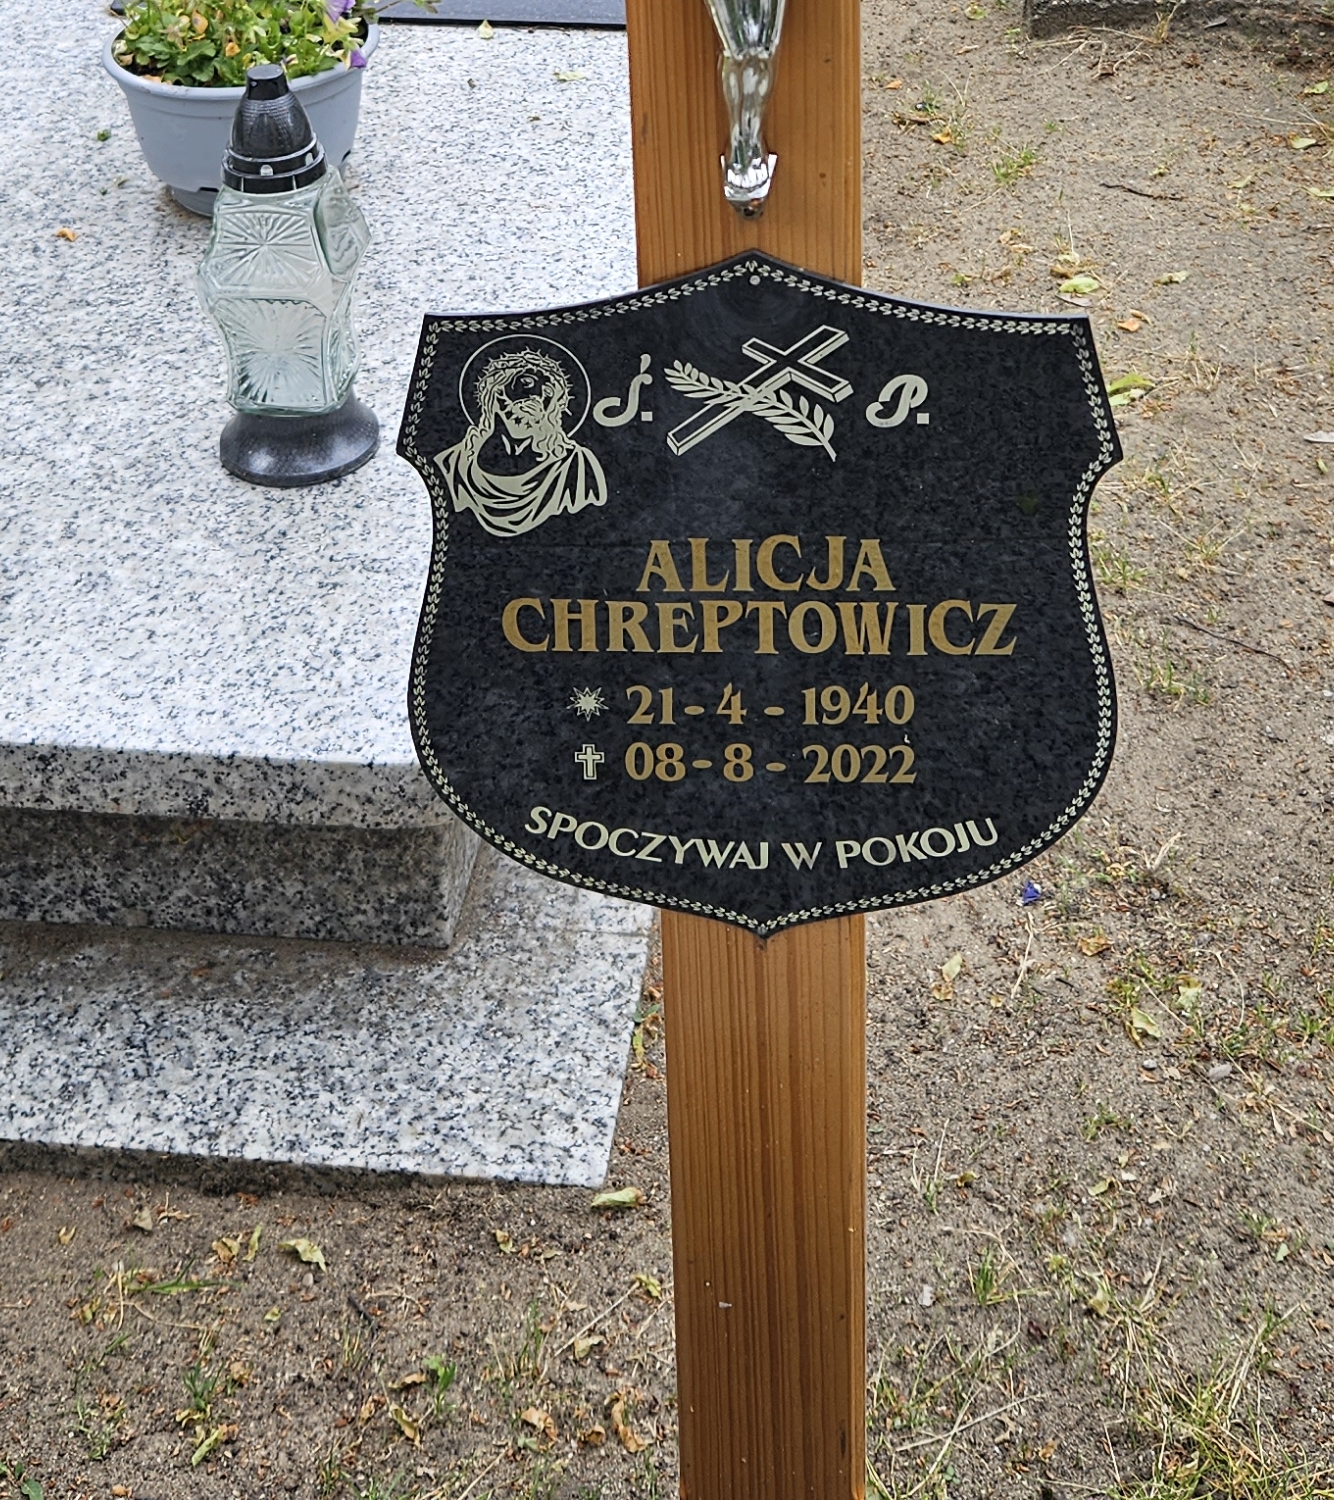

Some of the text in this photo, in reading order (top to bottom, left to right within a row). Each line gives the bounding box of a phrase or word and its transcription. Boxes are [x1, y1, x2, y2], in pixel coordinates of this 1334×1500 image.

[635, 533, 897, 593] ALICJA
[500, 596, 1019, 657] CHREPTOWICZ
[523, 804, 1001, 871] SPOCZYWAJ W POKOJU
